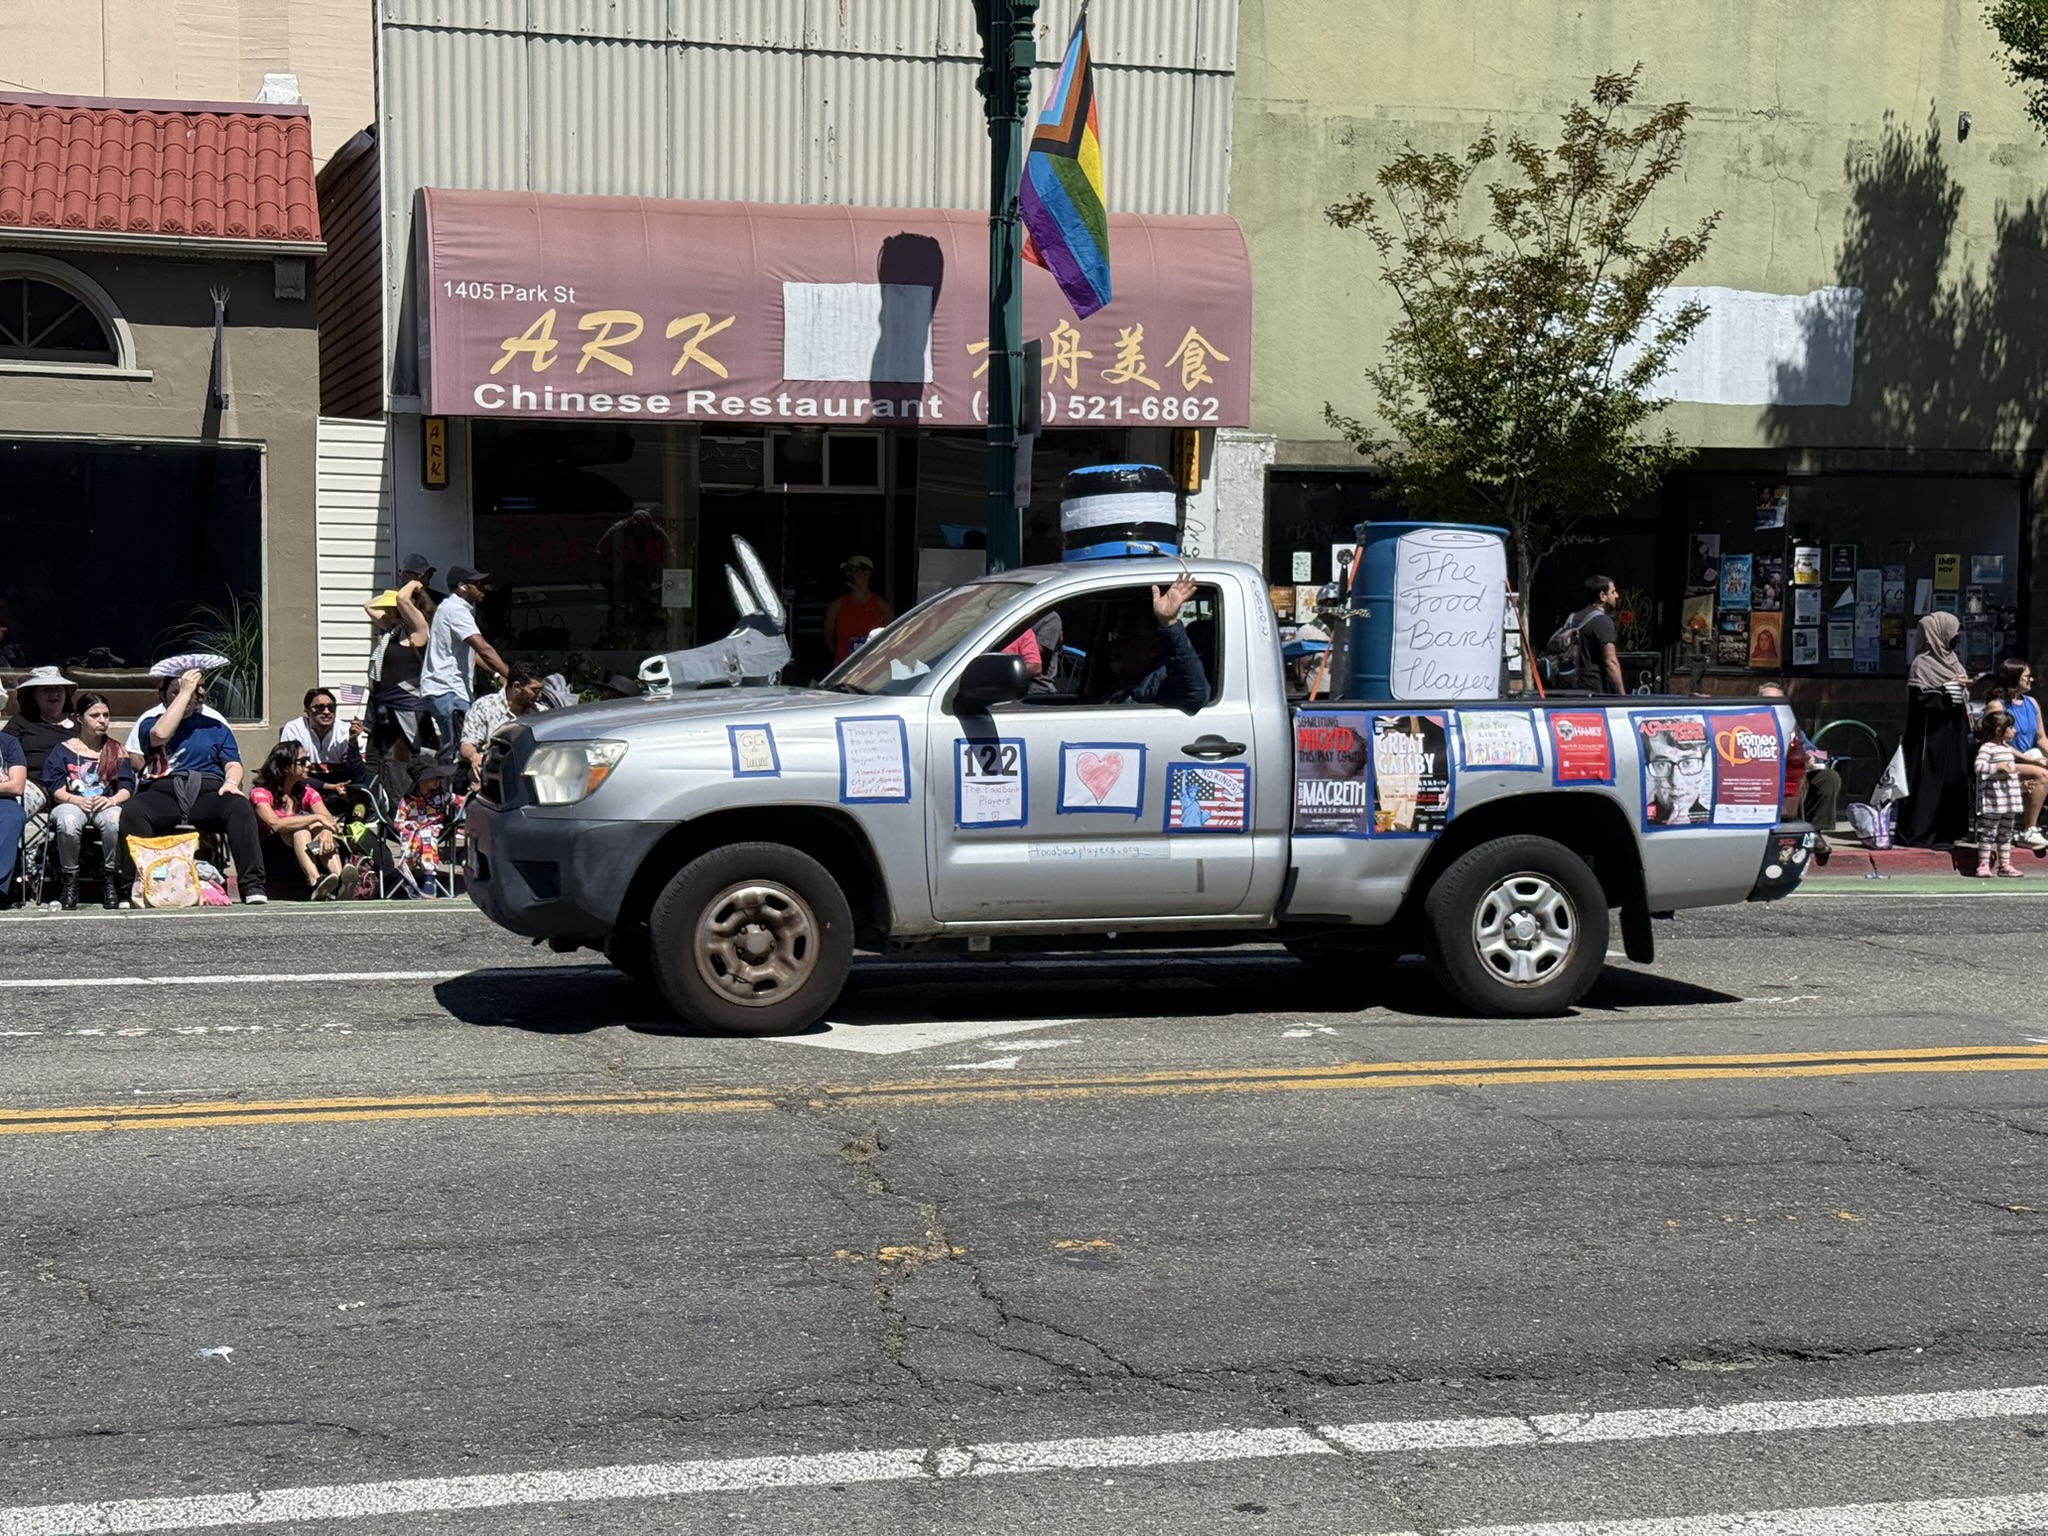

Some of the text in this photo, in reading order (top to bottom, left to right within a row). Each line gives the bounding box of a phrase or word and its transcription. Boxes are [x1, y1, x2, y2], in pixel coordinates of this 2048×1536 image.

[443, 280, 576, 303] 1405 Park St
[489, 308, 736, 379] ARK
[474, 383, 671, 412] Chinese
[686, 389, 943, 420] Restaurant
[1068, 395, 1220, 422] 521-6862
[429, 424, 443, 477] ARK
[1408, 550, 1481, 584] The
[1938, 558, 1956, 566] IMP
[1399, 585, 1487, 615] Food
[1400, 619, 1497, 650] Bank
[1297, 727, 1354, 751] WICKED
[1378, 732, 1425, 754] GREAT
[1736, 733, 1776, 746] Romeo
[964, 745, 1018, 777] 122
[1299, 752, 1314, 763] THIS
[1317, 752, 1334, 763] WAY
[1378, 753, 1435, 774] GATSBY
[1742, 746, 1777, 759] Juliet
[1200, 769, 1214, 779] NO
[979, 795, 1011, 807] Players
[1302, 781, 1366, 806] MACBETH
